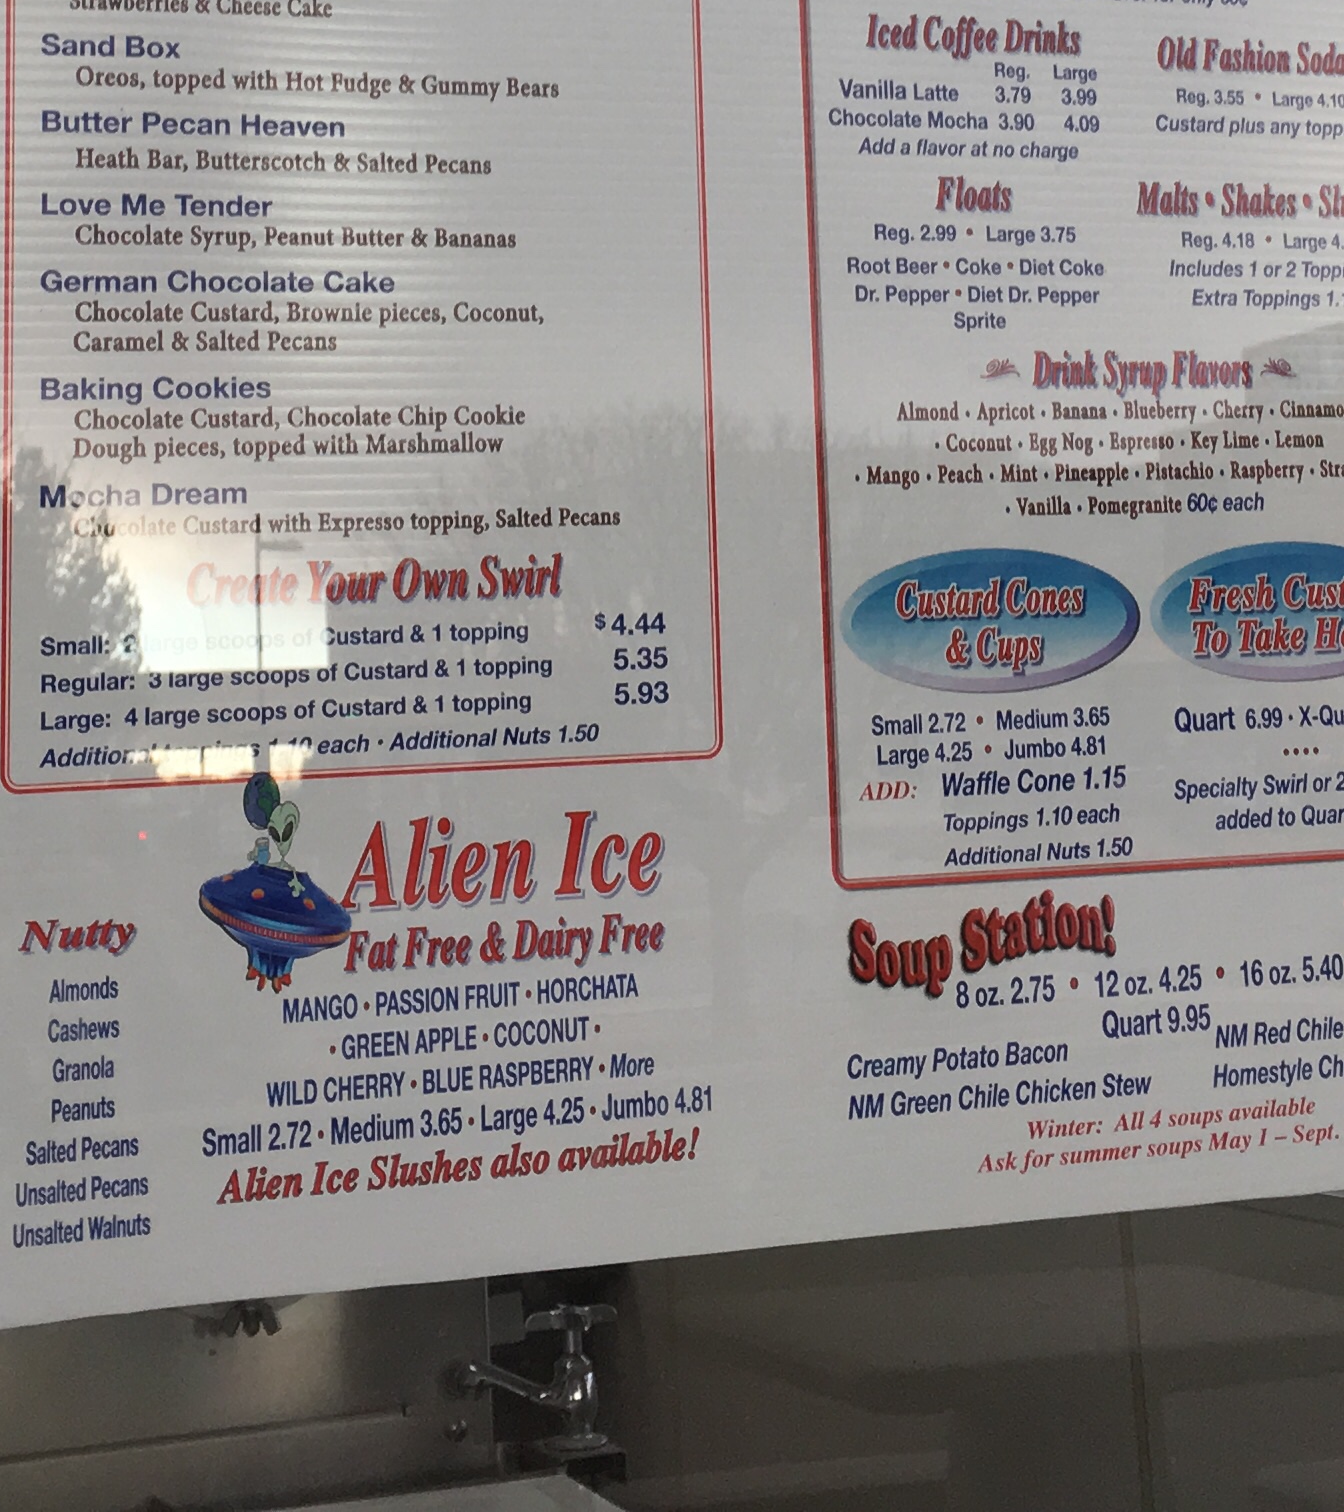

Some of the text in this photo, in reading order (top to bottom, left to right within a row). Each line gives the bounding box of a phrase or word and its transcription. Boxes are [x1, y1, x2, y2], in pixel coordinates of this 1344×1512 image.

[839, 78, 1097, 106] Vanilla Latte 3.79 3.99
[42, 193, 272, 217] Love Me Tender
[41, 270, 394, 293] German Chocolate Cake
[897, 401, 959, 421] Almond
[977, 402, 1035, 426] Apricot
[1052, 402, 1107, 420] Banana
[1123, 399, 1196, 424] Blueberry
[1213, 400, 1264, 424] Cherry
[896, 578, 1086, 621] Custard Cones
[946, 626, 1045, 673] & Cups
[340, 811, 665, 911] Alien Ice
[18, 919, 137, 956] Nutty
[847, 890, 1116, 998] Soup Station!
[49, 976, 118, 1003] Almonds
[283, 973, 638, 1023] MANGO PASSION FRUIT HORCHATA
[847, 1042, 1068, 1079] Creamy Potato Bacon
[1214, 1058, 1312, 1088] Homestyle
[1028, 1097, 1315, 1139] Winter: All 4 soups available
